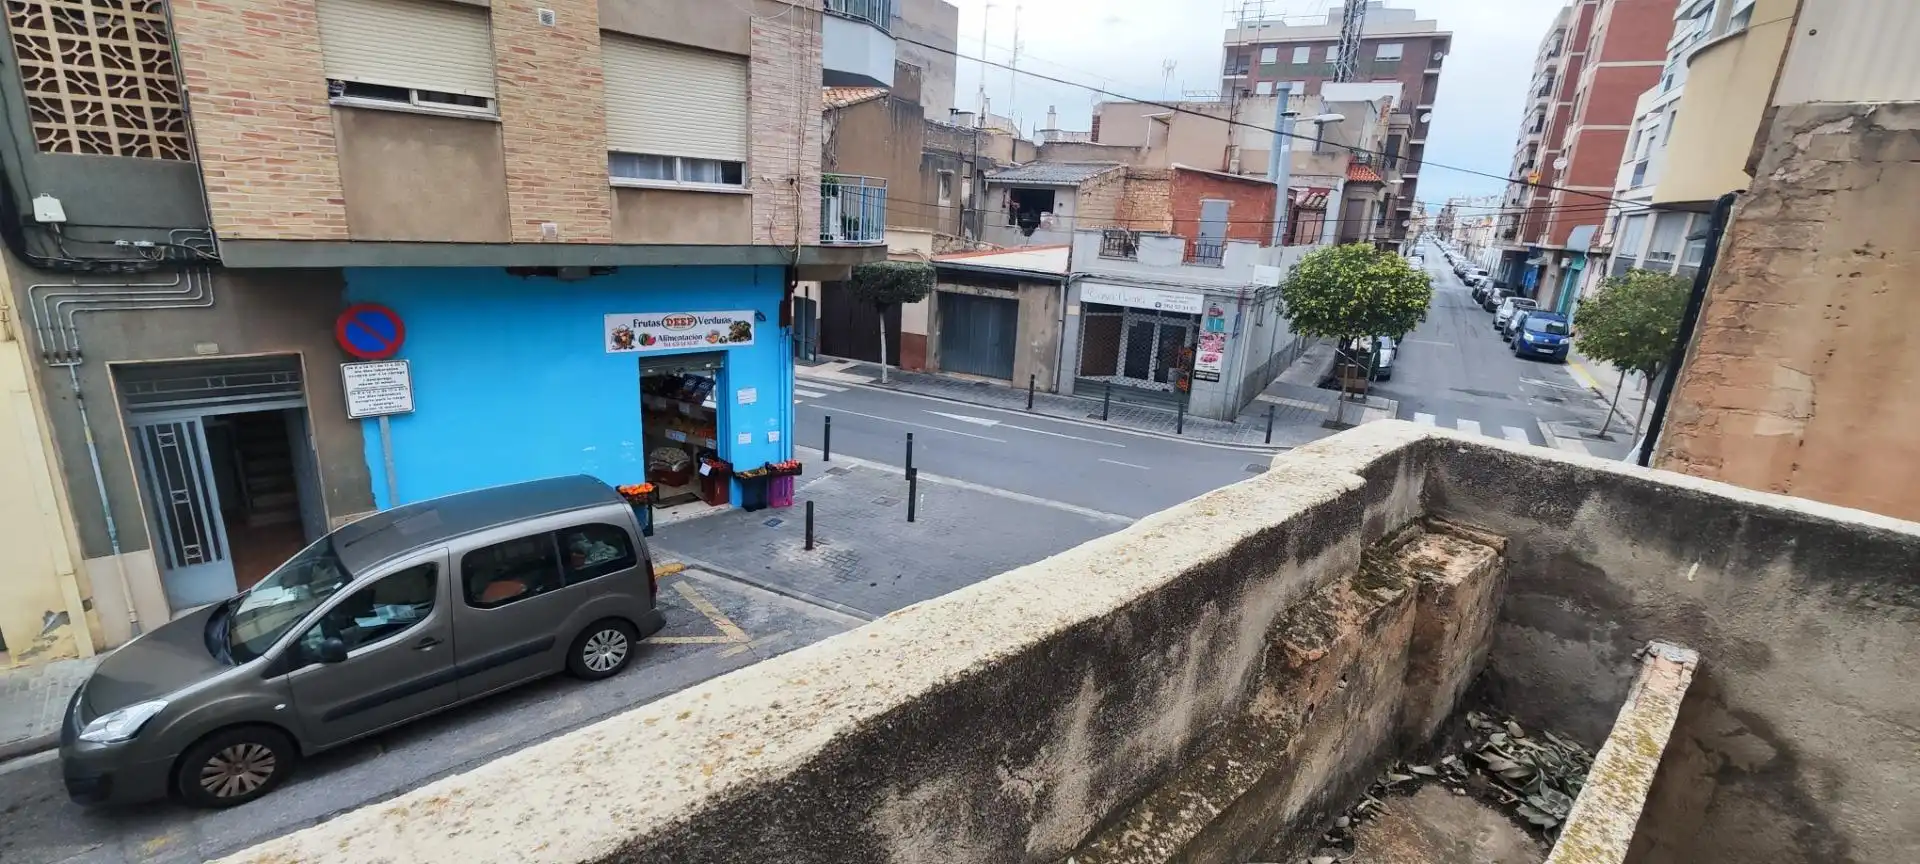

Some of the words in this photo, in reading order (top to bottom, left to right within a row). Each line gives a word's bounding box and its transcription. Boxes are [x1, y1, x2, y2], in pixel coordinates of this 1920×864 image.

[633, 318, 661, 328] Frutas
[665, 317, 694, 327] DEEP
[697, 315, 732, 325] Verduras
